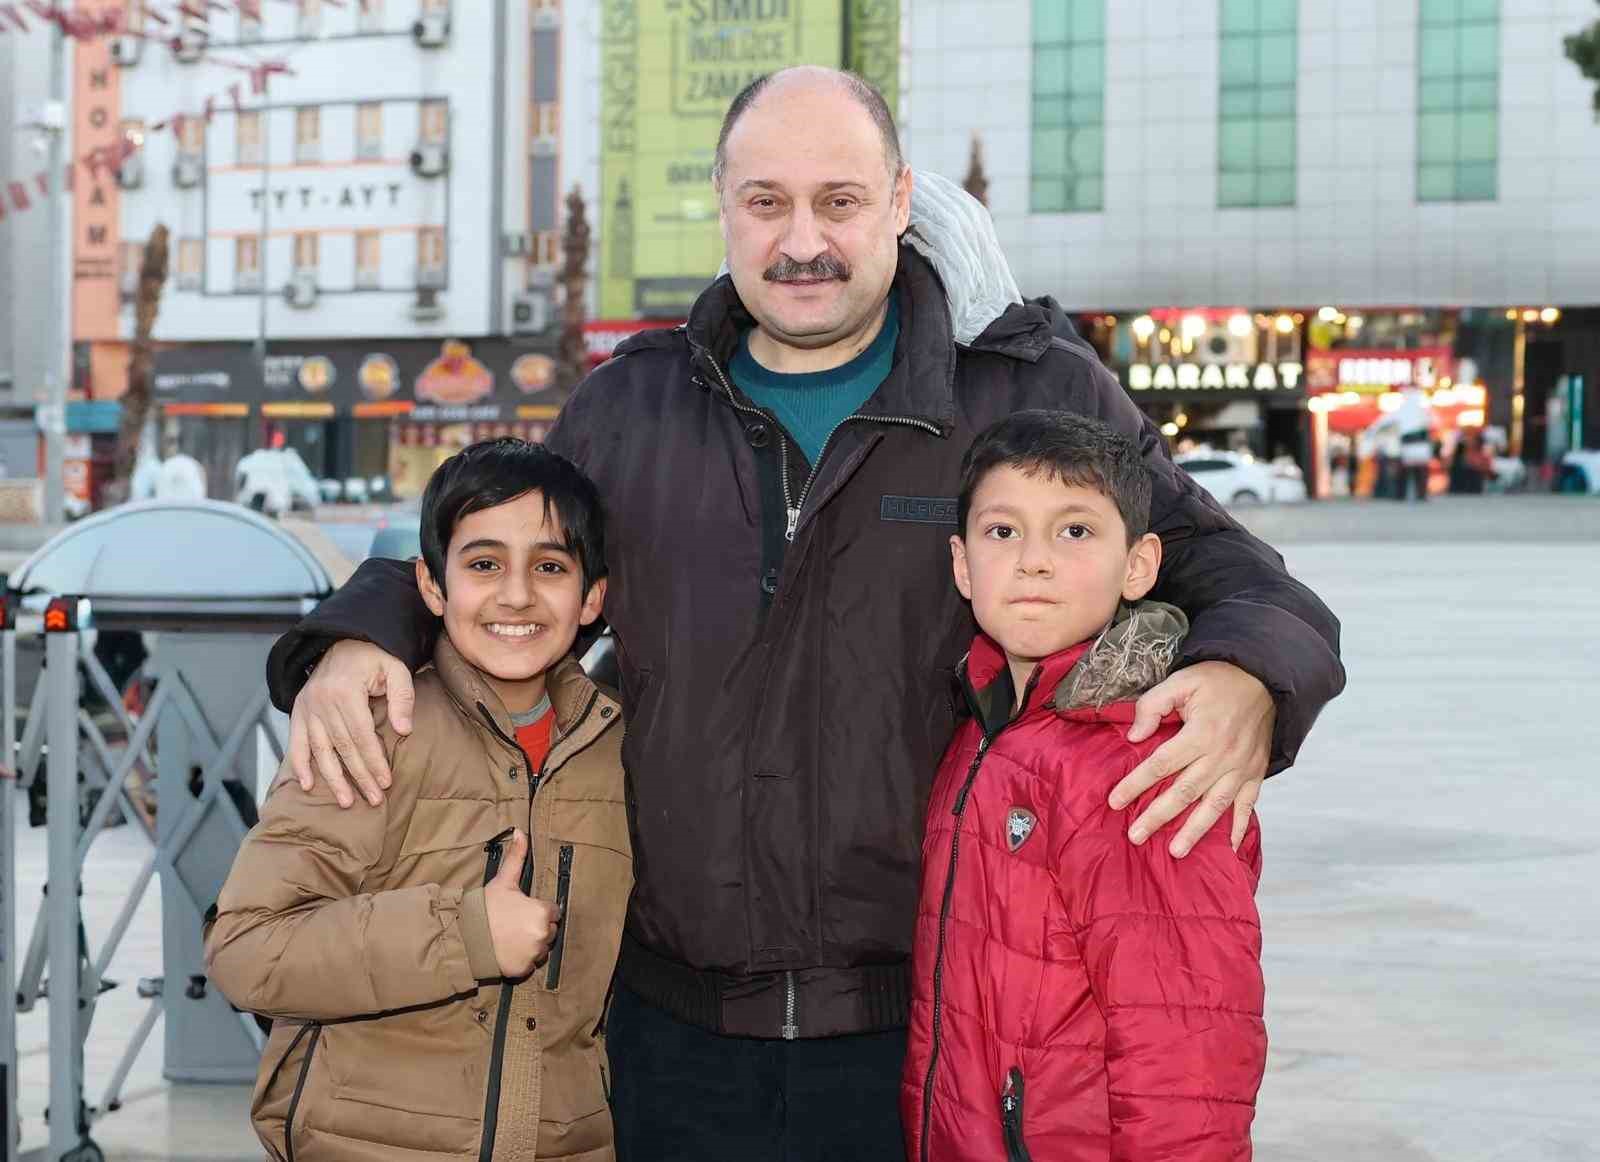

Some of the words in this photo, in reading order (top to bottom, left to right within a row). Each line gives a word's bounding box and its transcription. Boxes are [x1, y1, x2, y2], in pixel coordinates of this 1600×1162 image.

[607, 0, 636, 151] ENGLIS
[248, 184, 402, 211] TYT-AYT
[1129, 362, 1303, 391] BARAKAT
